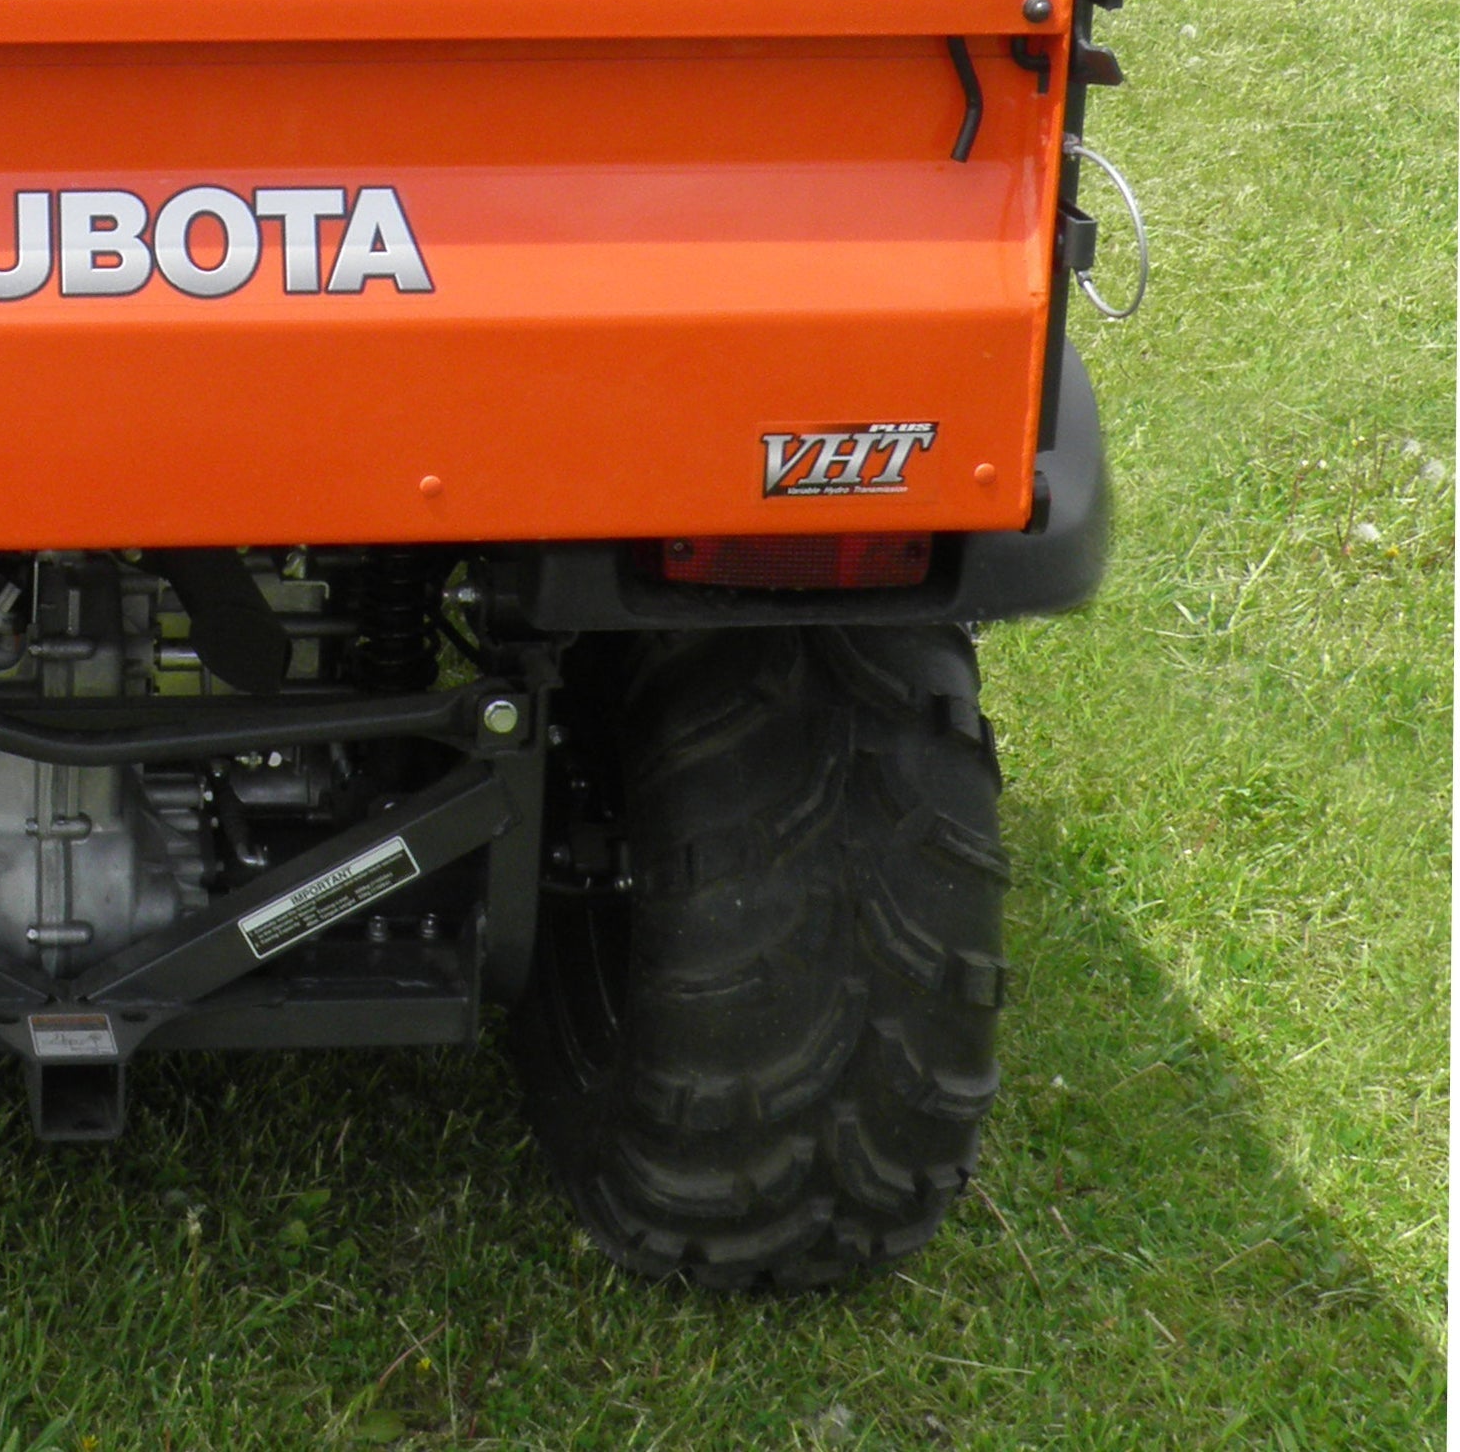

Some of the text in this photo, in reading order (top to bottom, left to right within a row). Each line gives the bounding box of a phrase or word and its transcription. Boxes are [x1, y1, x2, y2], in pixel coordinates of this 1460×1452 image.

[869, 423, 934, 432] PLUS
[762, 432, 936, 495] VHT
[787, 486, 821, 494] Variable
[824, 486, 850, 495] Hydro
[291, 866, 354, 905] IMPORTANT
